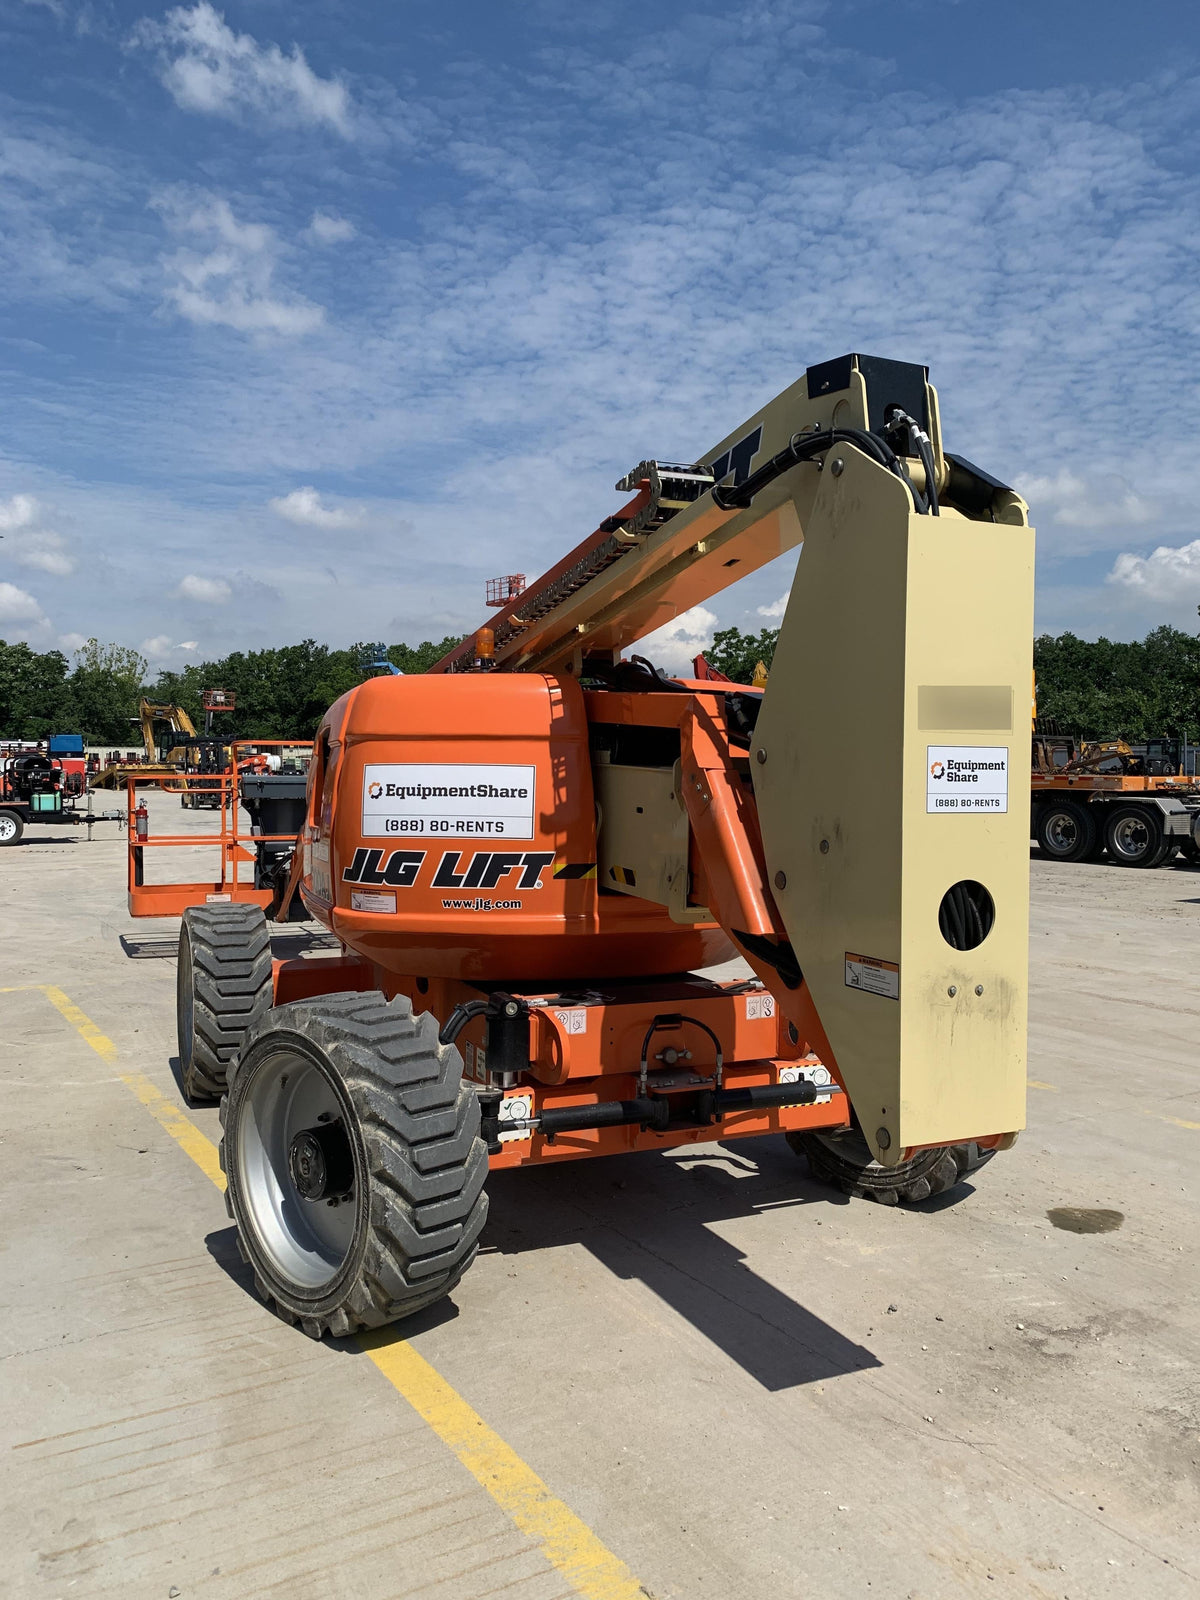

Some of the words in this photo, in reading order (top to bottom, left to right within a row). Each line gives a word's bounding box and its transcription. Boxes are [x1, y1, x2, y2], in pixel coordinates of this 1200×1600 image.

[947, 759, 1005, 772] Equipment
[946, 772, 978, 782] Share
[385, 783, 528, 800] EquipmentShare
[935, 798, 958, 808] (888)
[960, 799, 1000, 807] 80-RENTS
[385, 819, 424, 832] (888)
[429, 819, 505, 833] 80-RENTS
[342, 847, 427, 887] JLG
[441, 898, 522, 911] www.jlg.com
